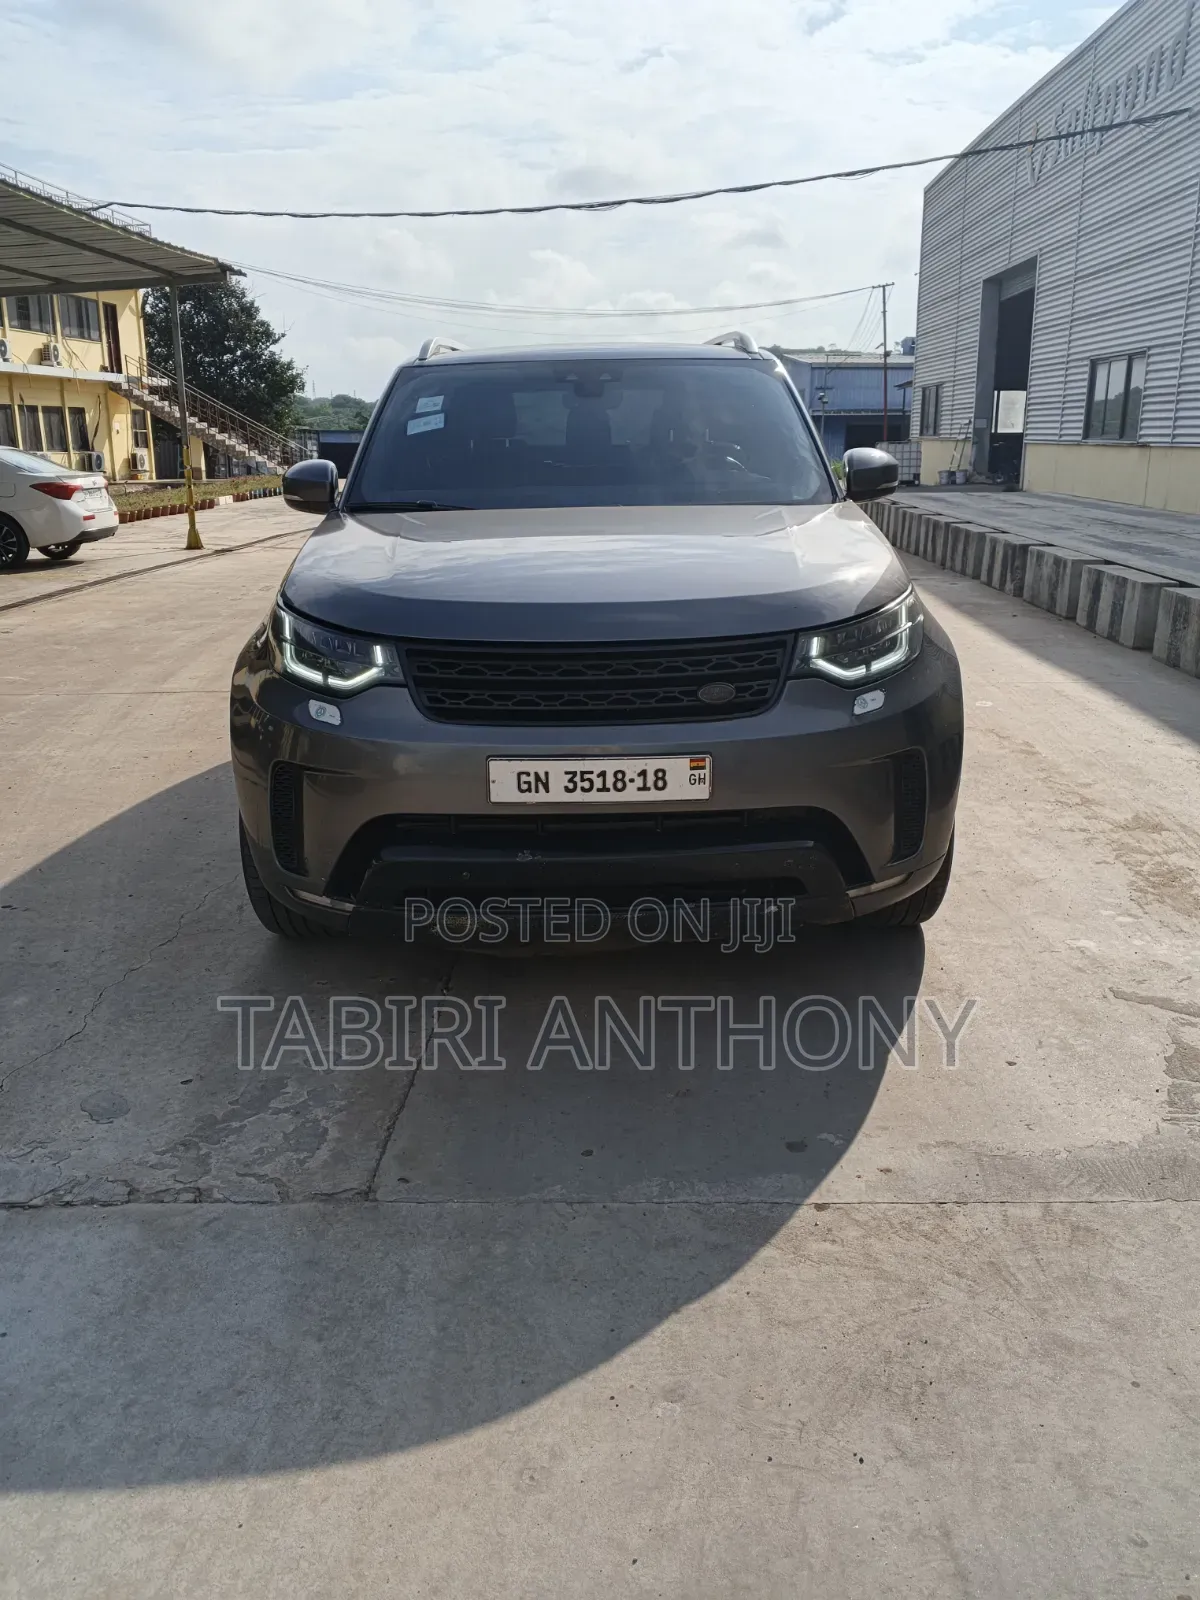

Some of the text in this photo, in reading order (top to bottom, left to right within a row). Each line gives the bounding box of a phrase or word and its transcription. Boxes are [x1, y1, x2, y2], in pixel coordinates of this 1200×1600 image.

[516, 768, 668, 794] GN 3518-18
[688, 773, 706, 786] GH
